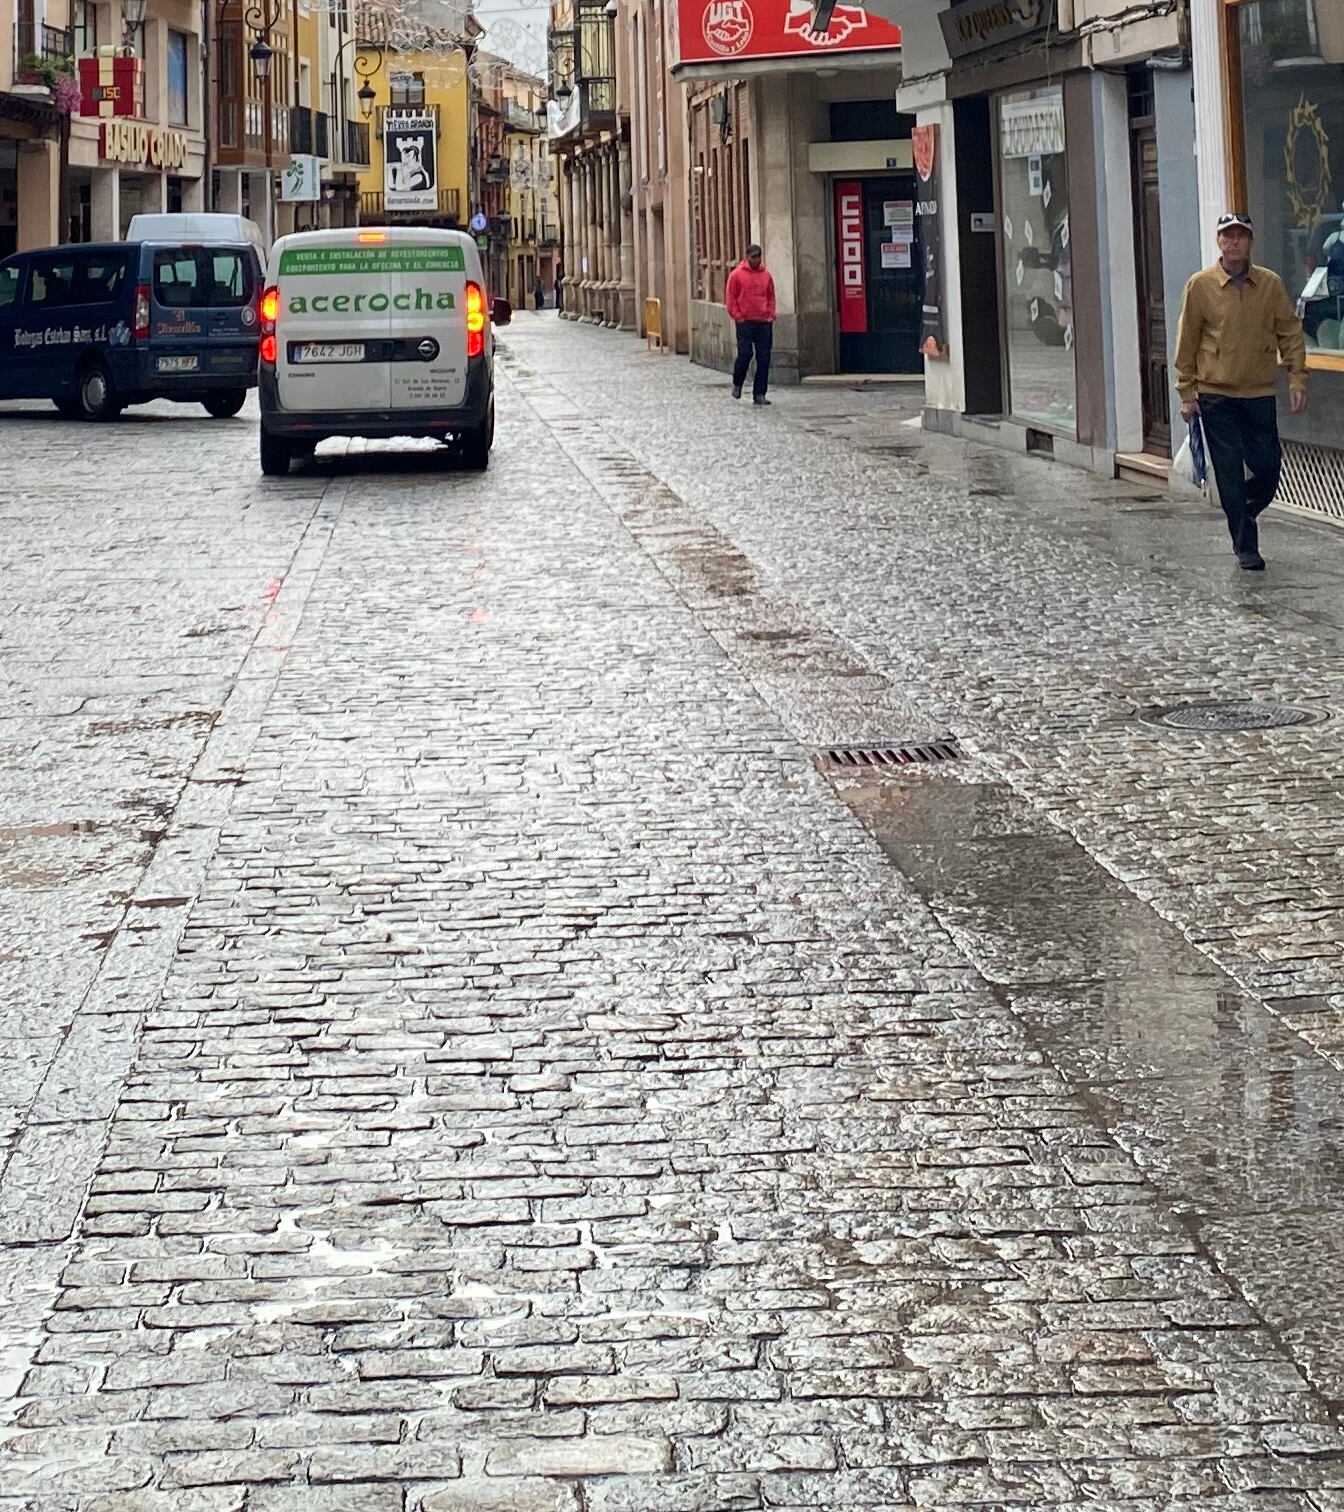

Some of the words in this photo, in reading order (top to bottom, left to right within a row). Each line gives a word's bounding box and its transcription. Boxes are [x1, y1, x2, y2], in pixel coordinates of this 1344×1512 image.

[708, 0, 745, 24] UGT
[105, 123, 149, 164] BASILIO
[150, 131, 187, 168] CRIADO
[841, 195, 863, 286] CCOO
[286, 263, 336, 273] EQUIPAMIENTO
[339, 263, 356, 271] PARA
[359, 262, 368, 270] LA
[371, 261, 402, 270] OFICINA
[413, 261, 422, 269] EL
[425, 260, 459, 269] COMERCIO
[296, 253, 317, 261] VENTA
[378, 251, 387, 259] DE
[391, 250, 449, 258] REVESTIMIENTOS
[288, 288, 455, 313] acerocha
[303, 346, 335, 357] 7642
[338, 345, 362, 356] JGH
